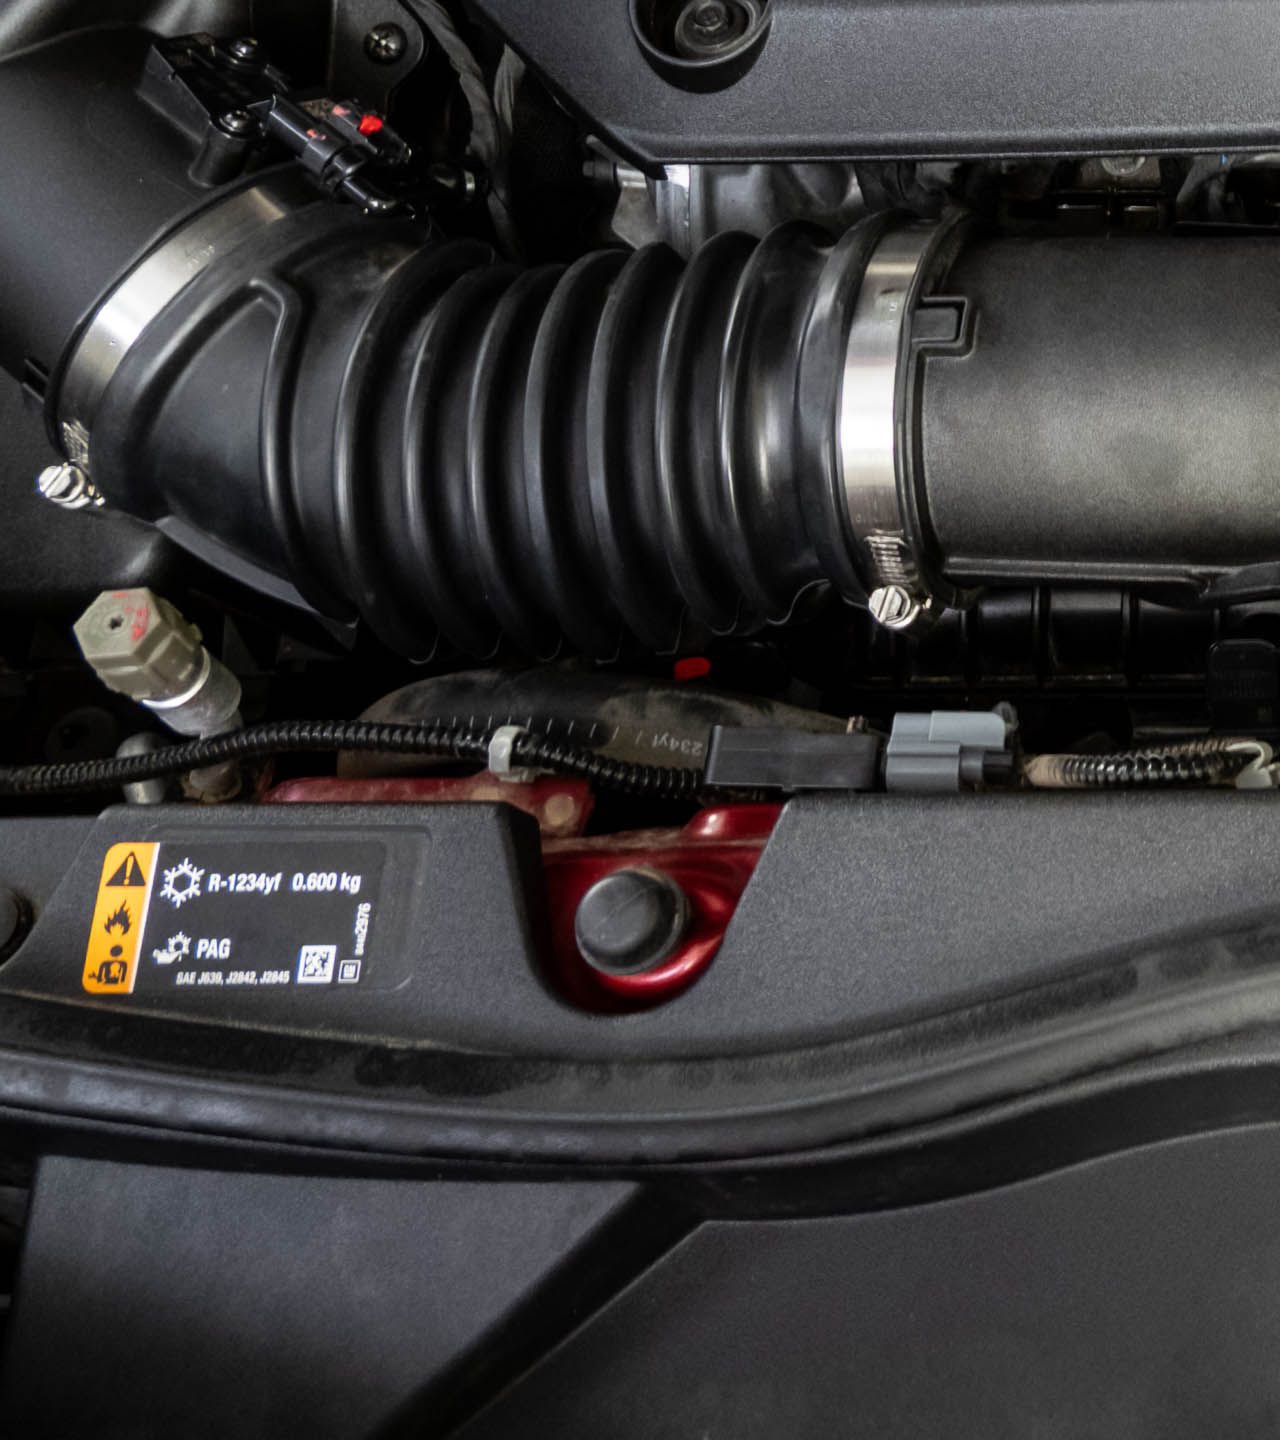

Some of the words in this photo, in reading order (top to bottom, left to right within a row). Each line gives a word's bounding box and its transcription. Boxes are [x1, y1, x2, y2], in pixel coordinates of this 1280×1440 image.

[207, 872, 283, 895] R-1234yf
[292, 872, 337, 892] 0.600
[338, 872, 362, 896] kg
[196, 938, 232, 960] PAG
